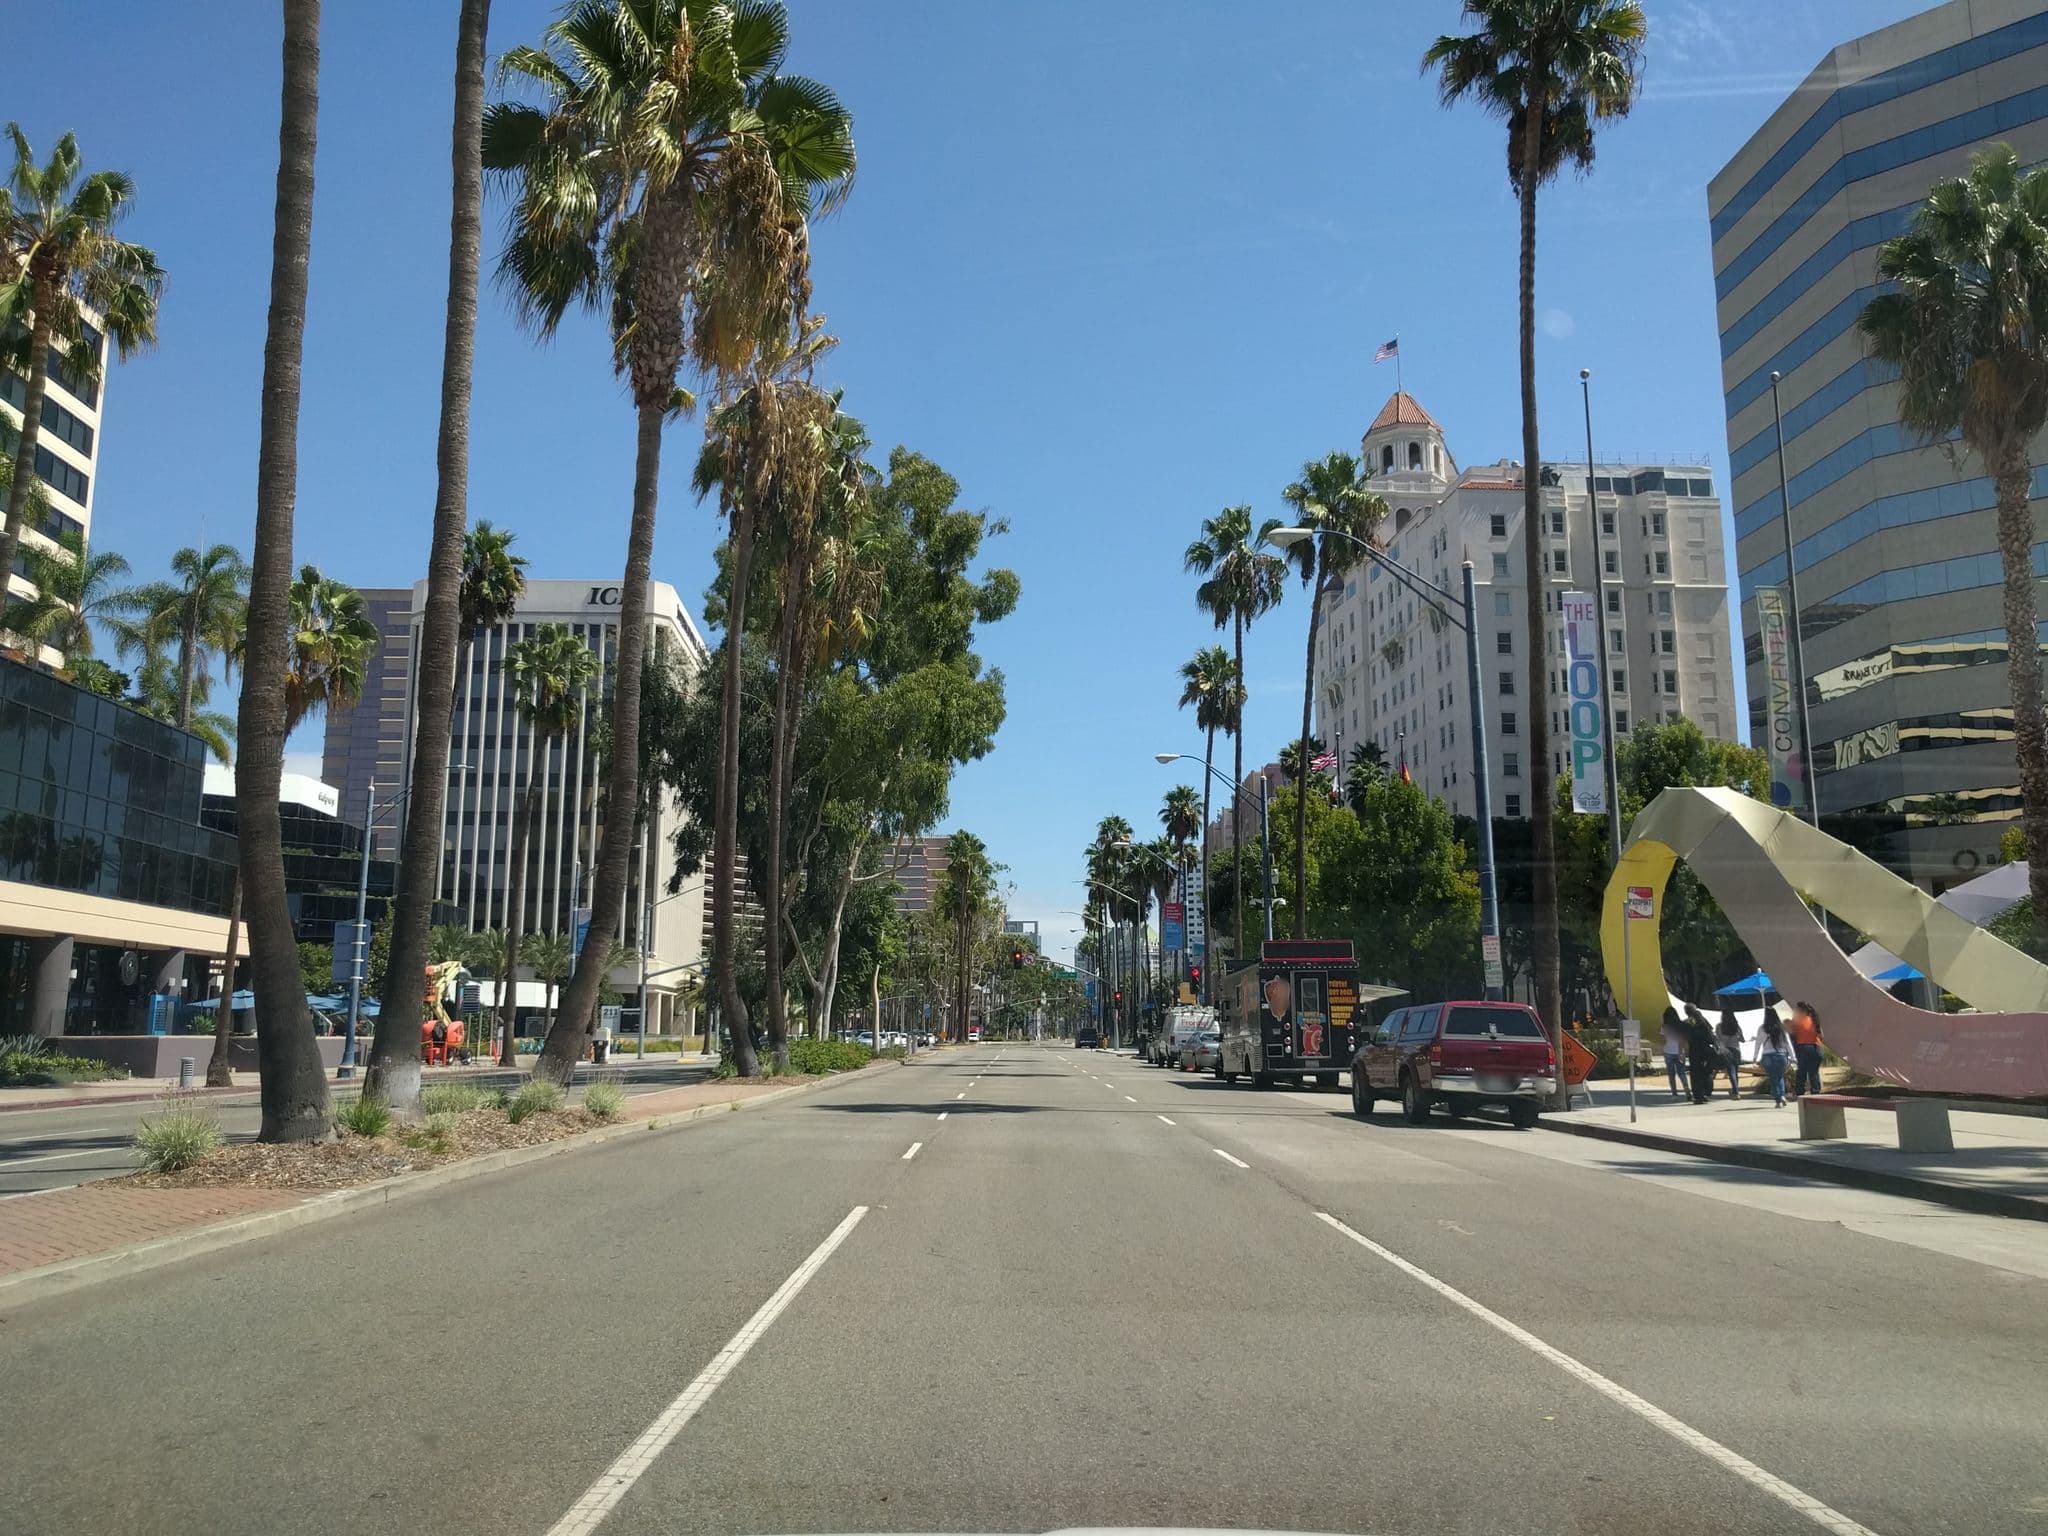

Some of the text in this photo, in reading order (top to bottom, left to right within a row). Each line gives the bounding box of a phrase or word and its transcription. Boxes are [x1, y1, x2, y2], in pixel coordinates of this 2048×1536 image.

[1564, 604, 1593, 621] THE
[1568, 622, 1601, 780] LOOP
[1765, 596, 1792, 752] CONVENTION
[603, 1008, 618, 1016] 211
